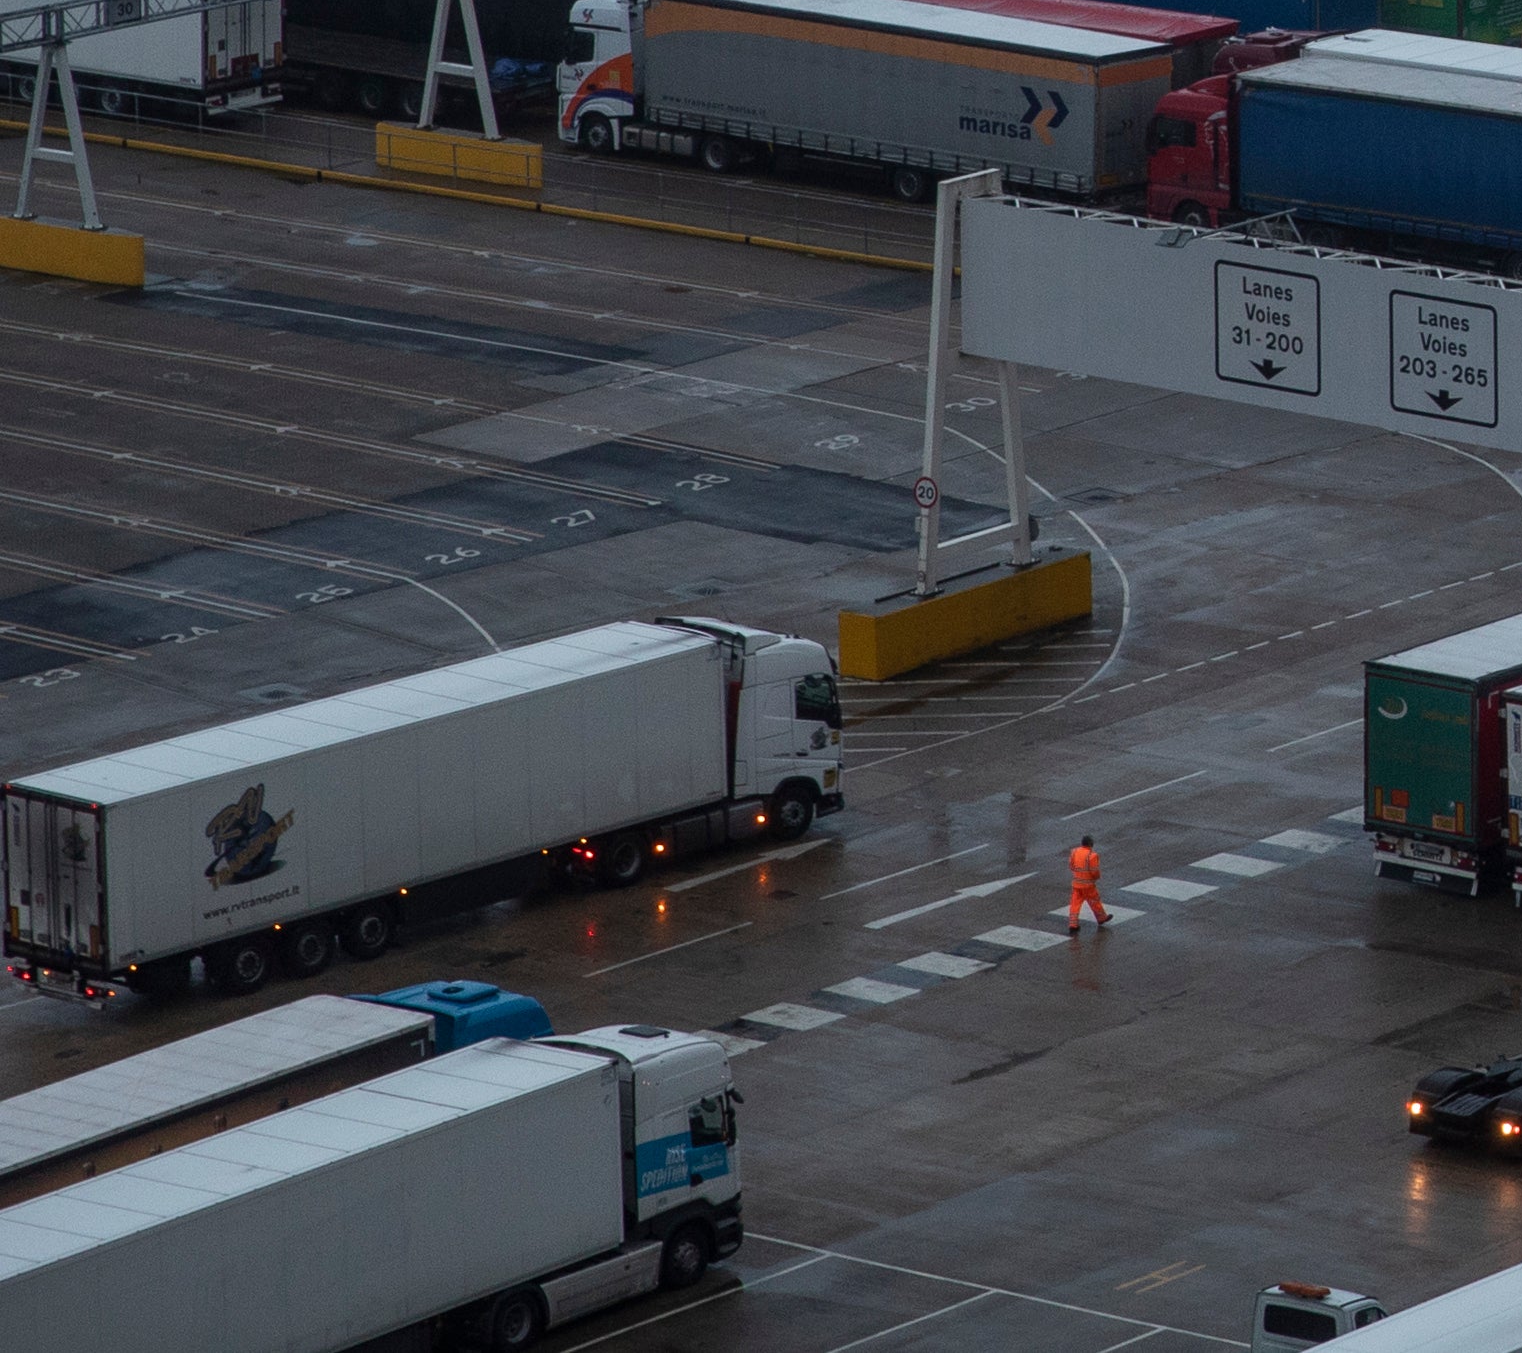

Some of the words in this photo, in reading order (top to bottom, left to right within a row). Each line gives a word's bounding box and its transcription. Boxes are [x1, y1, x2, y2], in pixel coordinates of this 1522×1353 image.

[116, 1, 134, 15] 30
[959, 115, 1031, 141] marisa
[1242, 276, 1294, 302] Lanes
[1244, 302, 1291, 327] Voies
[1418, 305, 1470, 332] Lanes
[1231, 325, 1252, 346] 31
[1265, 331, 1304, 355] 200
[1420, 331, 1468, 357] Voies
[1399, 355, 1437, 379] 203
[1452, 364, 1488, 388] 265
[944, 397, 998, 413] 30
[814, 433, 860, 451] 29
[675, 472, 731, 491] 28
[918, 485, 934, 500] 20
[549, 509, 596, 527] 27
[424, 546, 482, 565] 26
[294, 583, 354, 604] 25
[160, 626, 220, 644] 24
[19, 667, 81, 688] 23
[202, 884, 301, 920] www.rvtransport.lt
